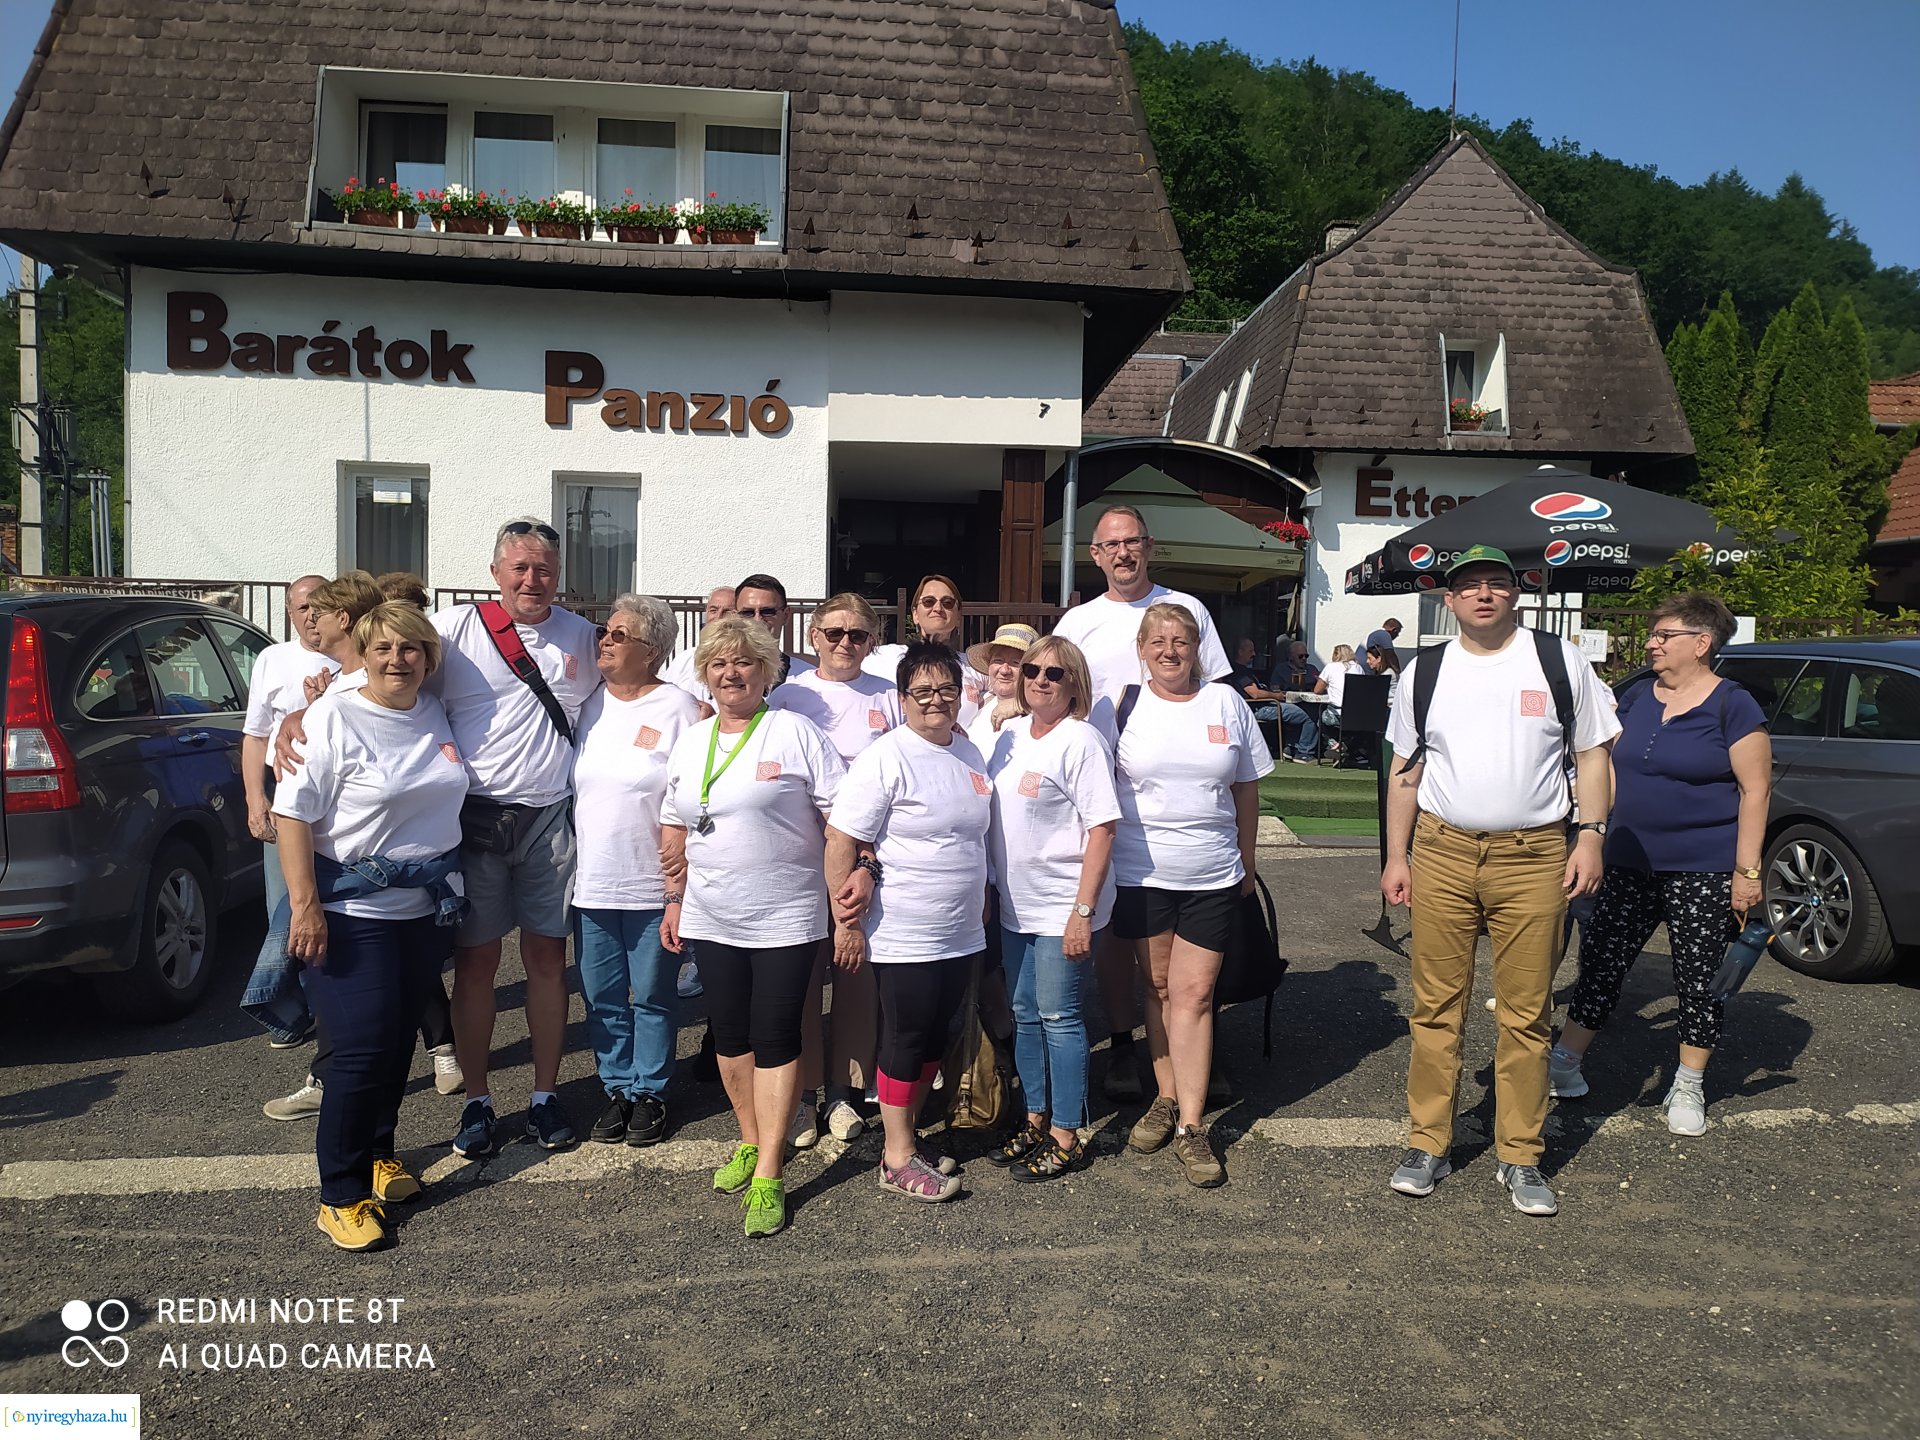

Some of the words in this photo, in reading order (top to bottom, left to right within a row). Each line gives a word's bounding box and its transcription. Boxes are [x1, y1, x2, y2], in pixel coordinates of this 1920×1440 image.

[166, 291, 477, 384] Barátok
[545, 350, 791, 433] Panzió
[1038, 402, 1051, 419] 7
[1549, 522, 1616, 534] pepsi
[1437, 551, 1462, 566] pe
[1574, 543, 1630, 561] pepsi
